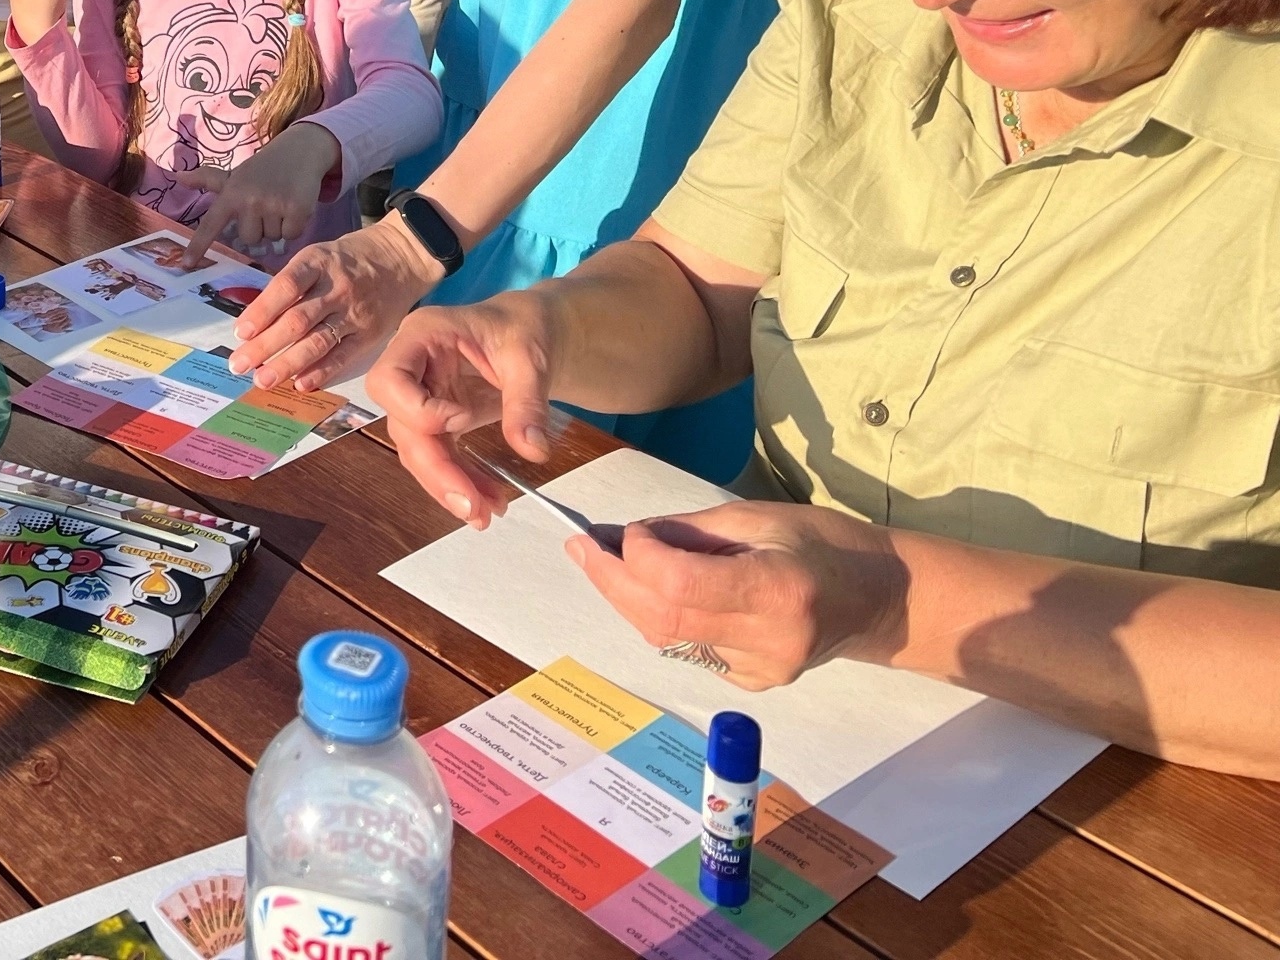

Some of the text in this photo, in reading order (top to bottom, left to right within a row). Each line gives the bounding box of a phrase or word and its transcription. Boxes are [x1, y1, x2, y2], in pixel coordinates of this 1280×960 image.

[140, 513, 226, 544] ФЛОМАСТЕРЫ
[117, 544, 213, 576] champions
[105, 604, 136, 627] #1
[528, 691, 600, 736] Путешествия
[457, 721, 548, 783] Дети, творчество
[641, 763, 694, 796] Карьера
[596, 816, 612, 826] Я
[488, 829, 589, 902] Самореализация,
[532, 845, 567, 869] слава
[709, 859, 740, 876] STICK
[761, 837, 811, 869] Знания
[624, 926, 673, 960] атство
